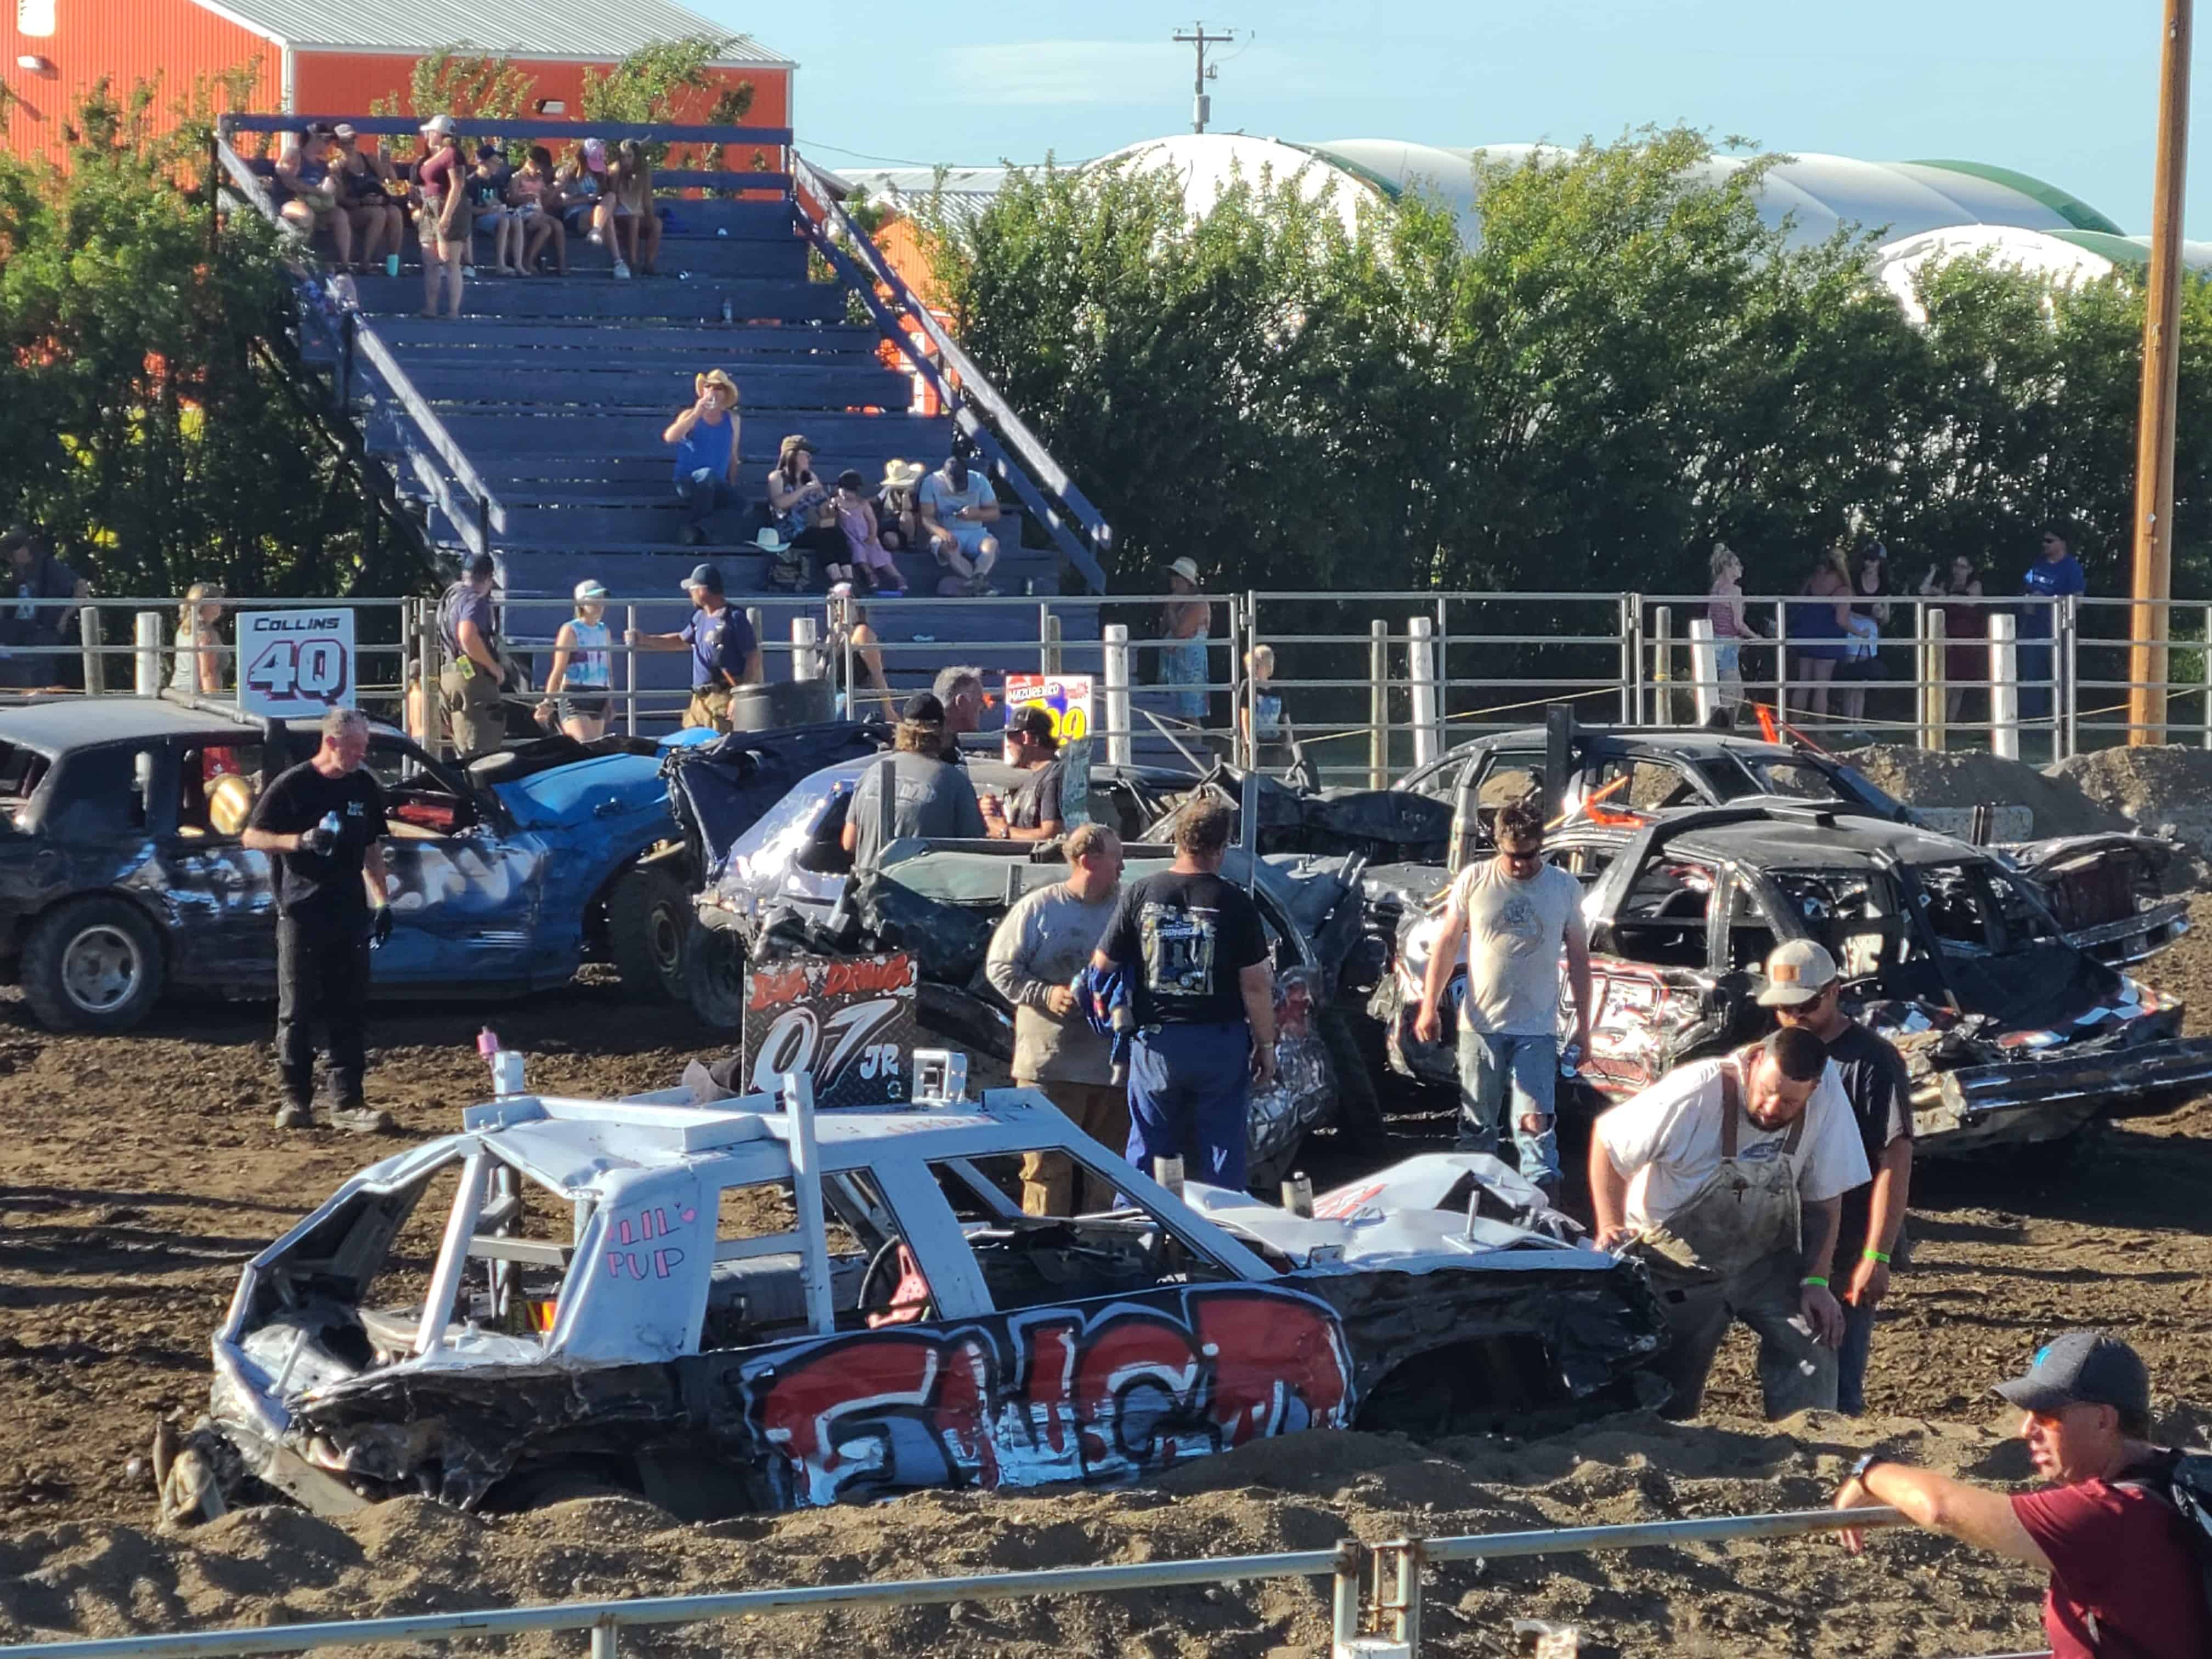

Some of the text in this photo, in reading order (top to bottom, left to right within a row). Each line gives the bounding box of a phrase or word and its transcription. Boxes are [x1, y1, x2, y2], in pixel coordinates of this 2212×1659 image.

[247, 639, 348, 706] 4Q
[749, 953, 912, 1010] BIG DAWG
[749, 998, 899, 1096] 07 JR
[607, 1248, 684, 1280] PUP
